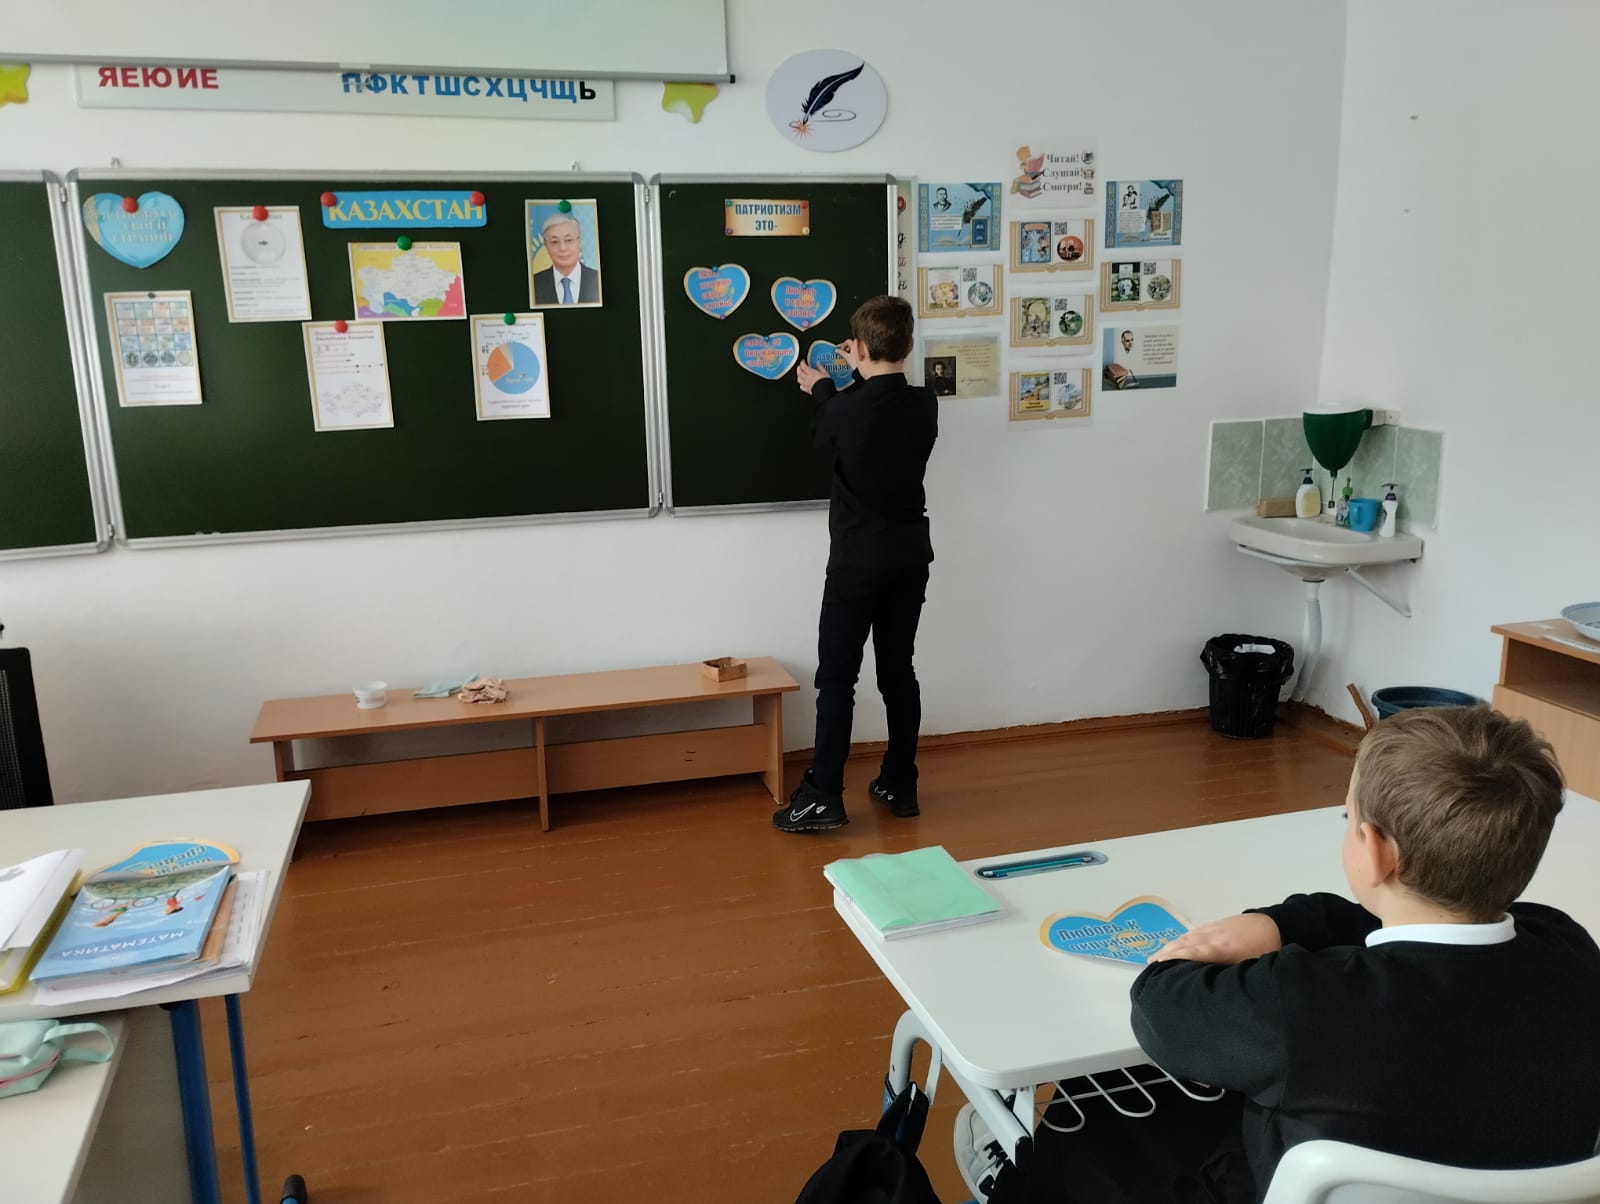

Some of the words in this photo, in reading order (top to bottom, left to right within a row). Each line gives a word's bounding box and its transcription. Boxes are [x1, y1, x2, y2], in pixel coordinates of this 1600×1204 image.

[1046, 153, 1080, 164] Читай!
[1043, 167, 1084, 180] Слушай!
[1043, 181, 1083, 193] Смотри!
[328, 199, 483, 222] КАЗАХСТАН
[735, 203, 801, 216] ПАТРИОТИЗМ
[1057, 922, 1123, 941] Любовь
[1070, 927, 1181, 952] окружающей
[61, 930, 184, 958] МАТЕМАТИКА
